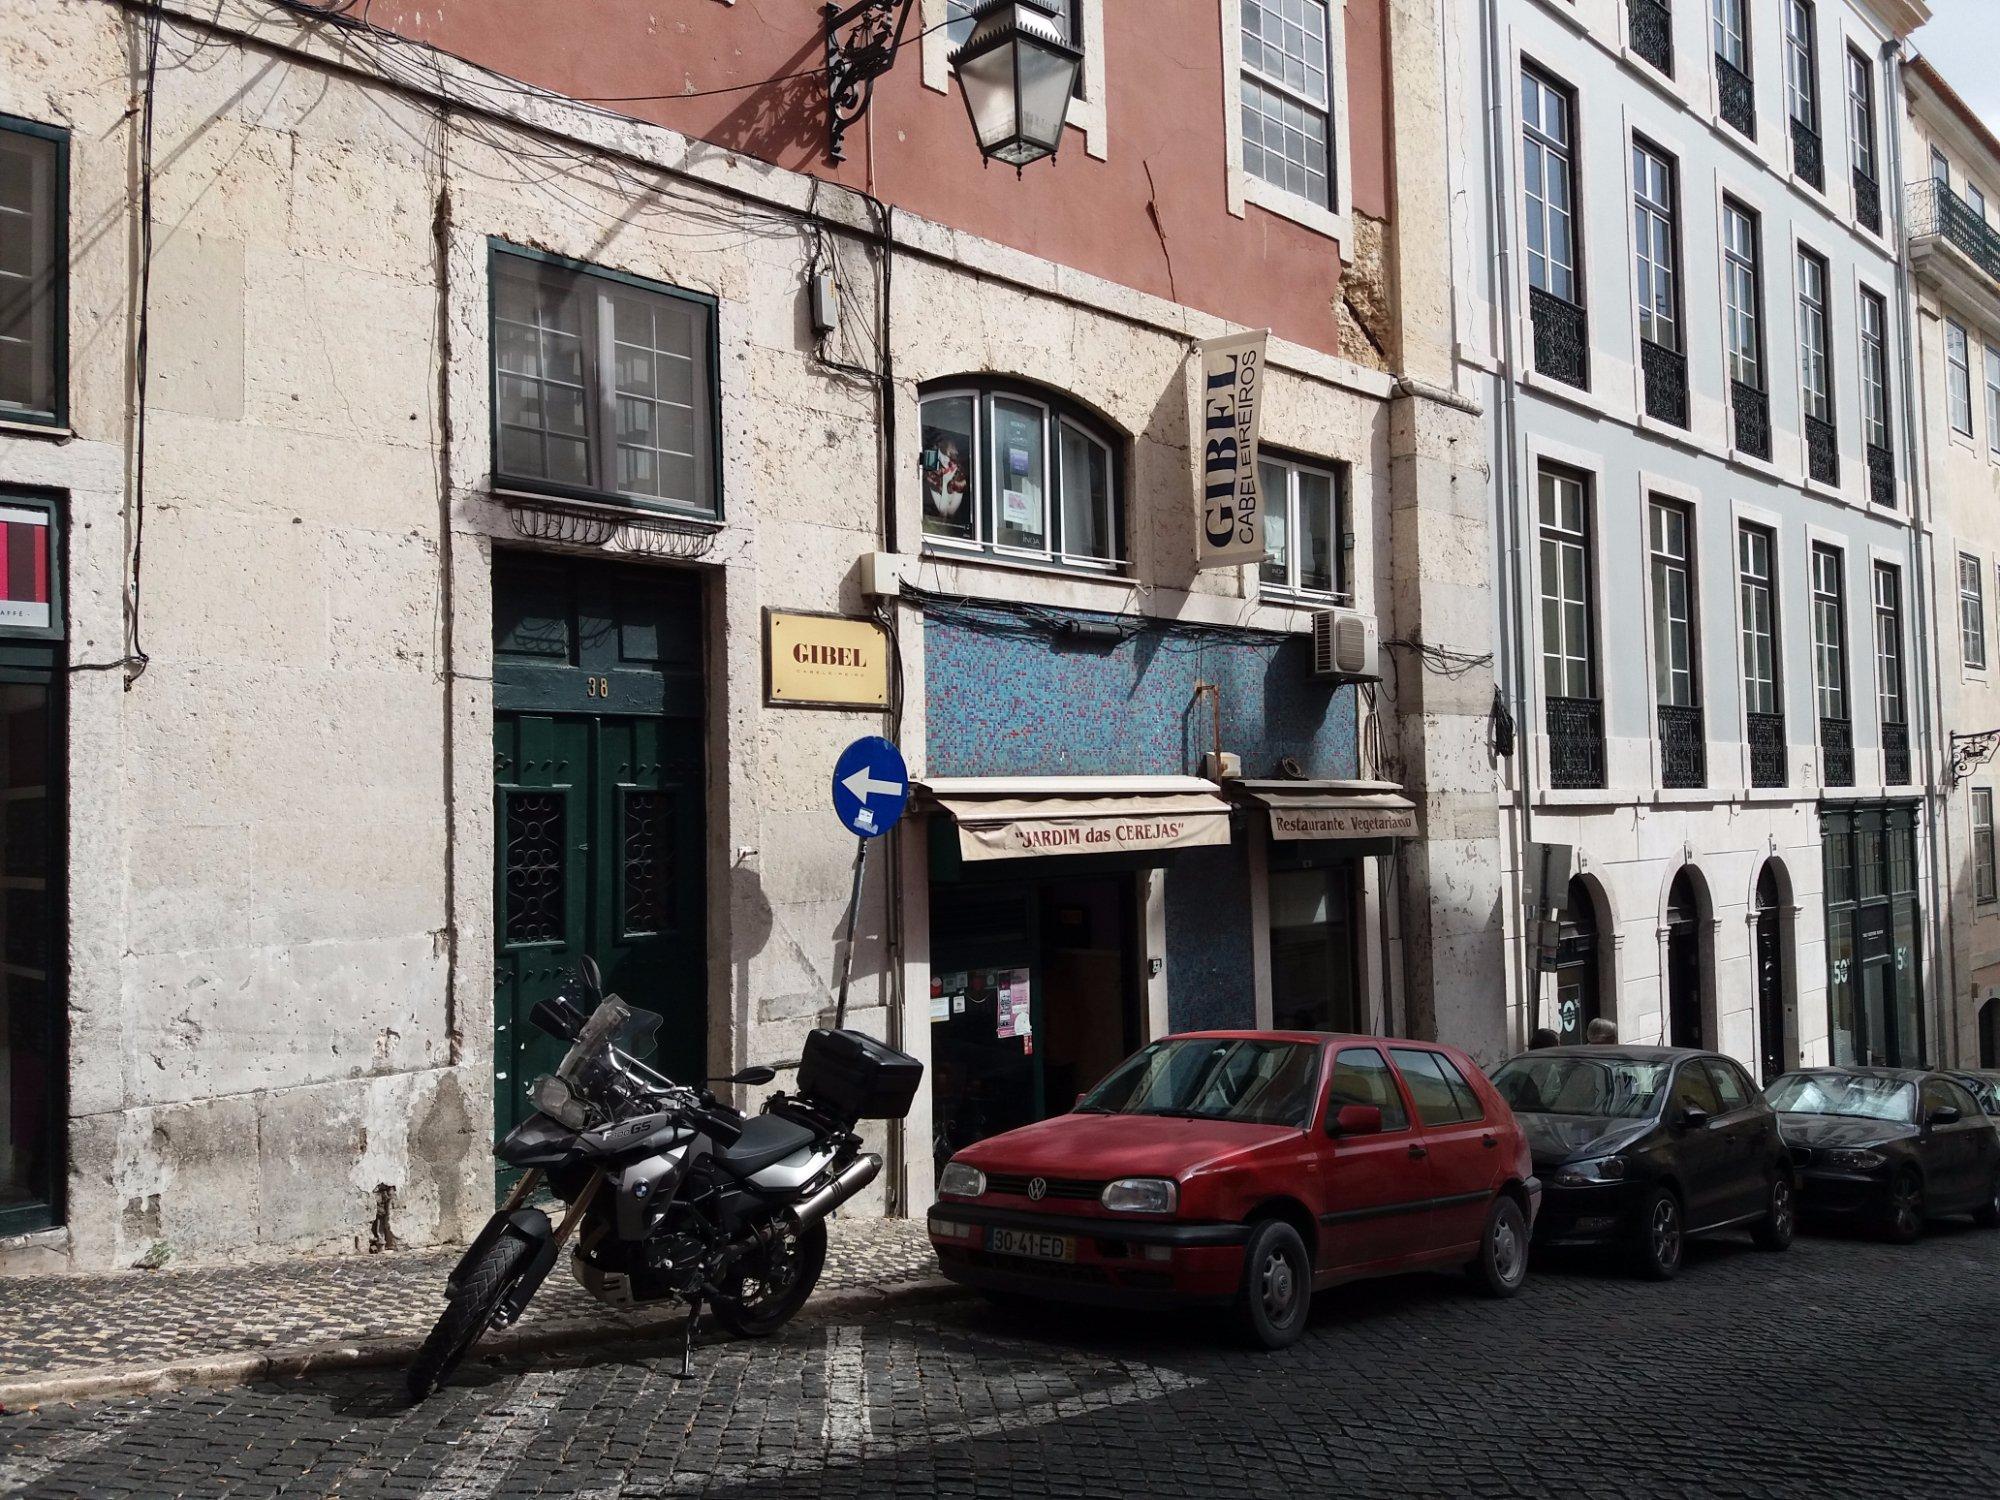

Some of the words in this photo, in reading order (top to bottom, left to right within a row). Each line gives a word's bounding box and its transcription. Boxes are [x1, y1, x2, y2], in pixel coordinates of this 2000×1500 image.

[1206, 354, 1239, 548] GIBEL
[1238, 350, 1257, 544] CABELEIREIROS
[793, 643, 867, 667] GIBEL
[588, 677, 608, 697] 38
[1085, 827, 1111, 843] das
[1276, 817, 1345, 831] Restaurante
[1350, 816, 1412, 833] Vegetariano
